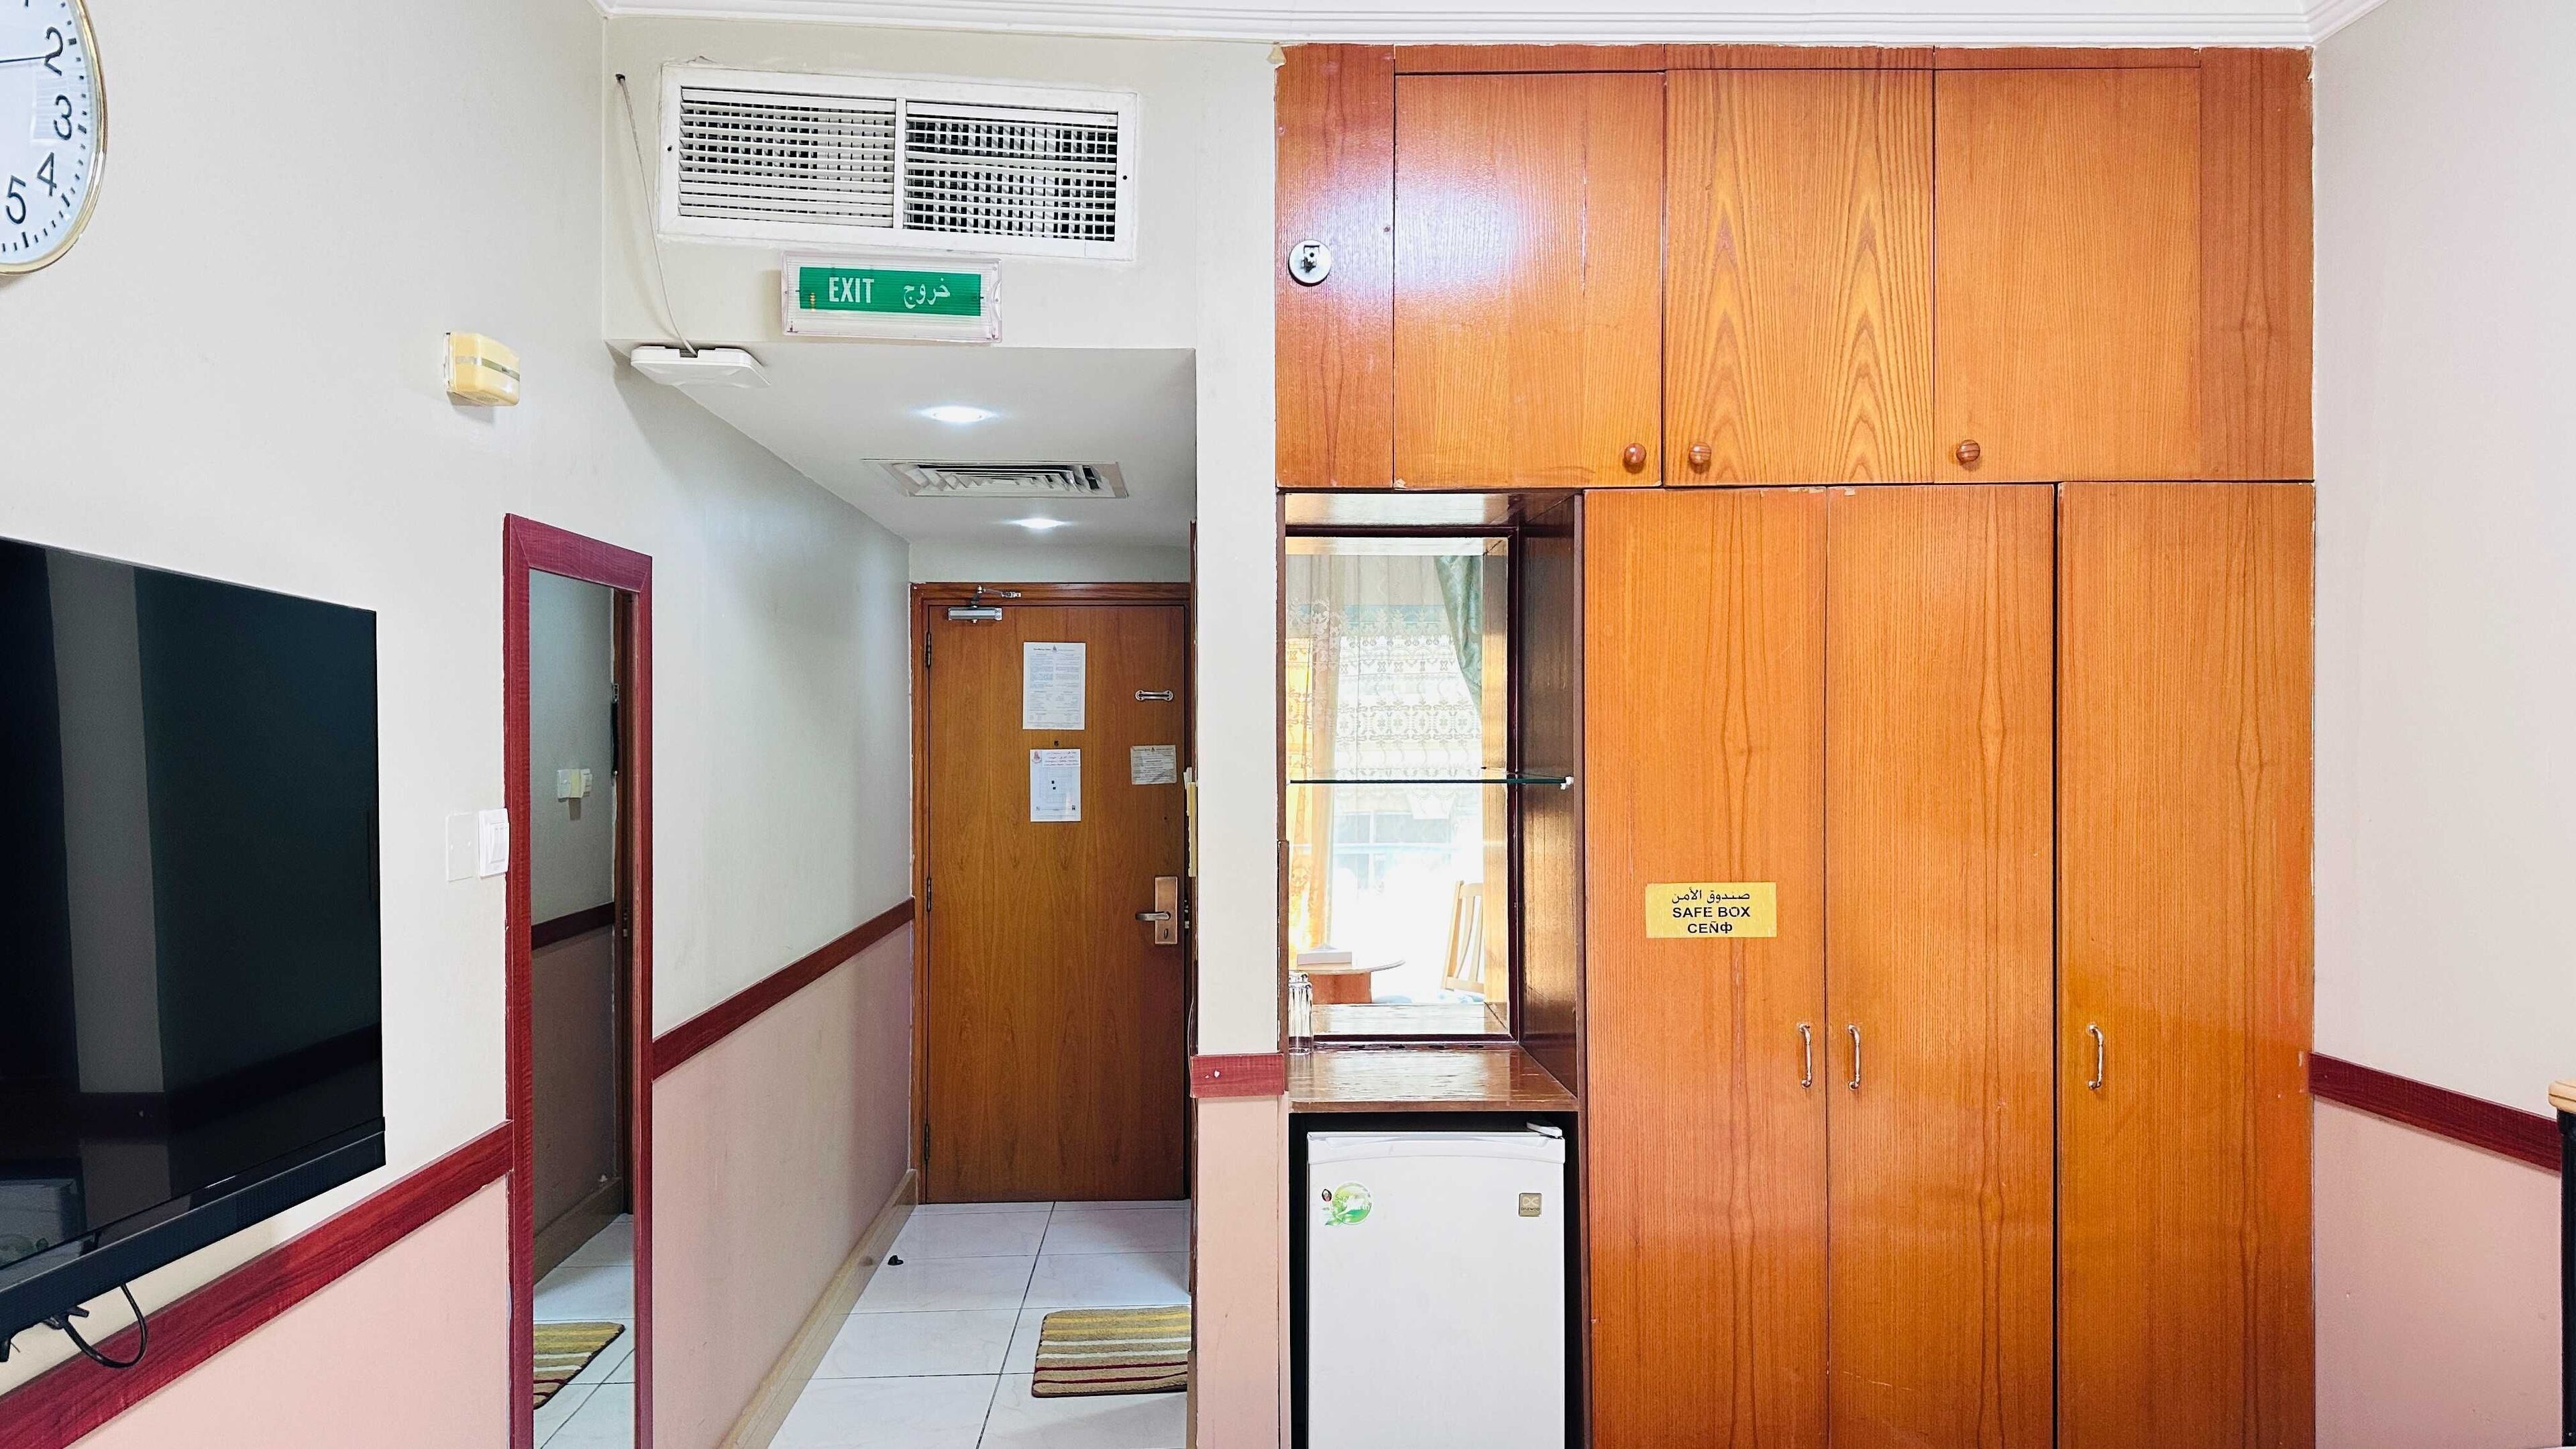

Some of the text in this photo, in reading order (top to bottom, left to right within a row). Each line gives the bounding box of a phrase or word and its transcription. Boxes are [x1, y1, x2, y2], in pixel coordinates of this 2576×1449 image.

[44, 27, 62, 76] 2
[54, 95, 72, 140] 3
[37, 152, 56, 197] 4
[6, 175, 26, 224] 5
[829, 277, 874, 303] EXIT
[904, 278, 951, 309] خروج
[1672, 887, 1750, 904] صندوق الأمن
[1673, 906, 1751, 918] SAFE BOX
